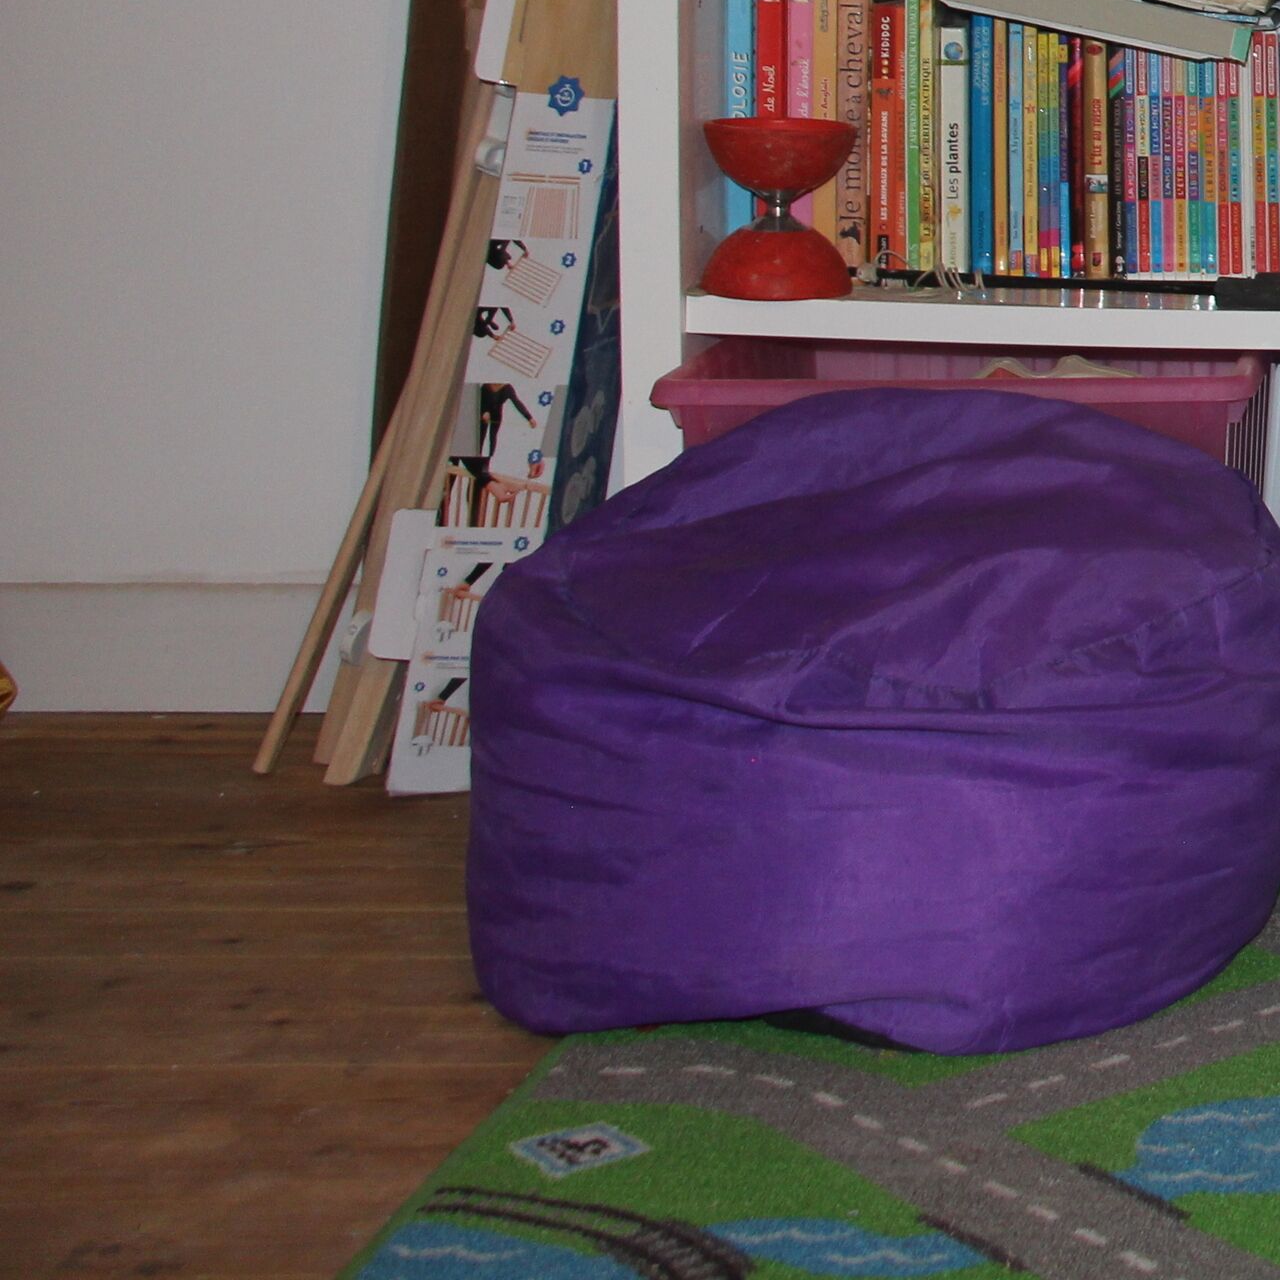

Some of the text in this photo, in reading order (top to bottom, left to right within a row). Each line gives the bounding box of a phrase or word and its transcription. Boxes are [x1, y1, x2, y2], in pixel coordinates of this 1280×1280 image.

[819, 79, 830, 109] Anglais
[839, 3, 865, 223] Je à cheval
[921, 58, 932, 236] LE SECRET DU GUERRIER PACIFIQUE
[880, 111, 889, 220] LES ANIMAUX DE LA SAVANE
[946, 122, 961, 199] Les plantes
